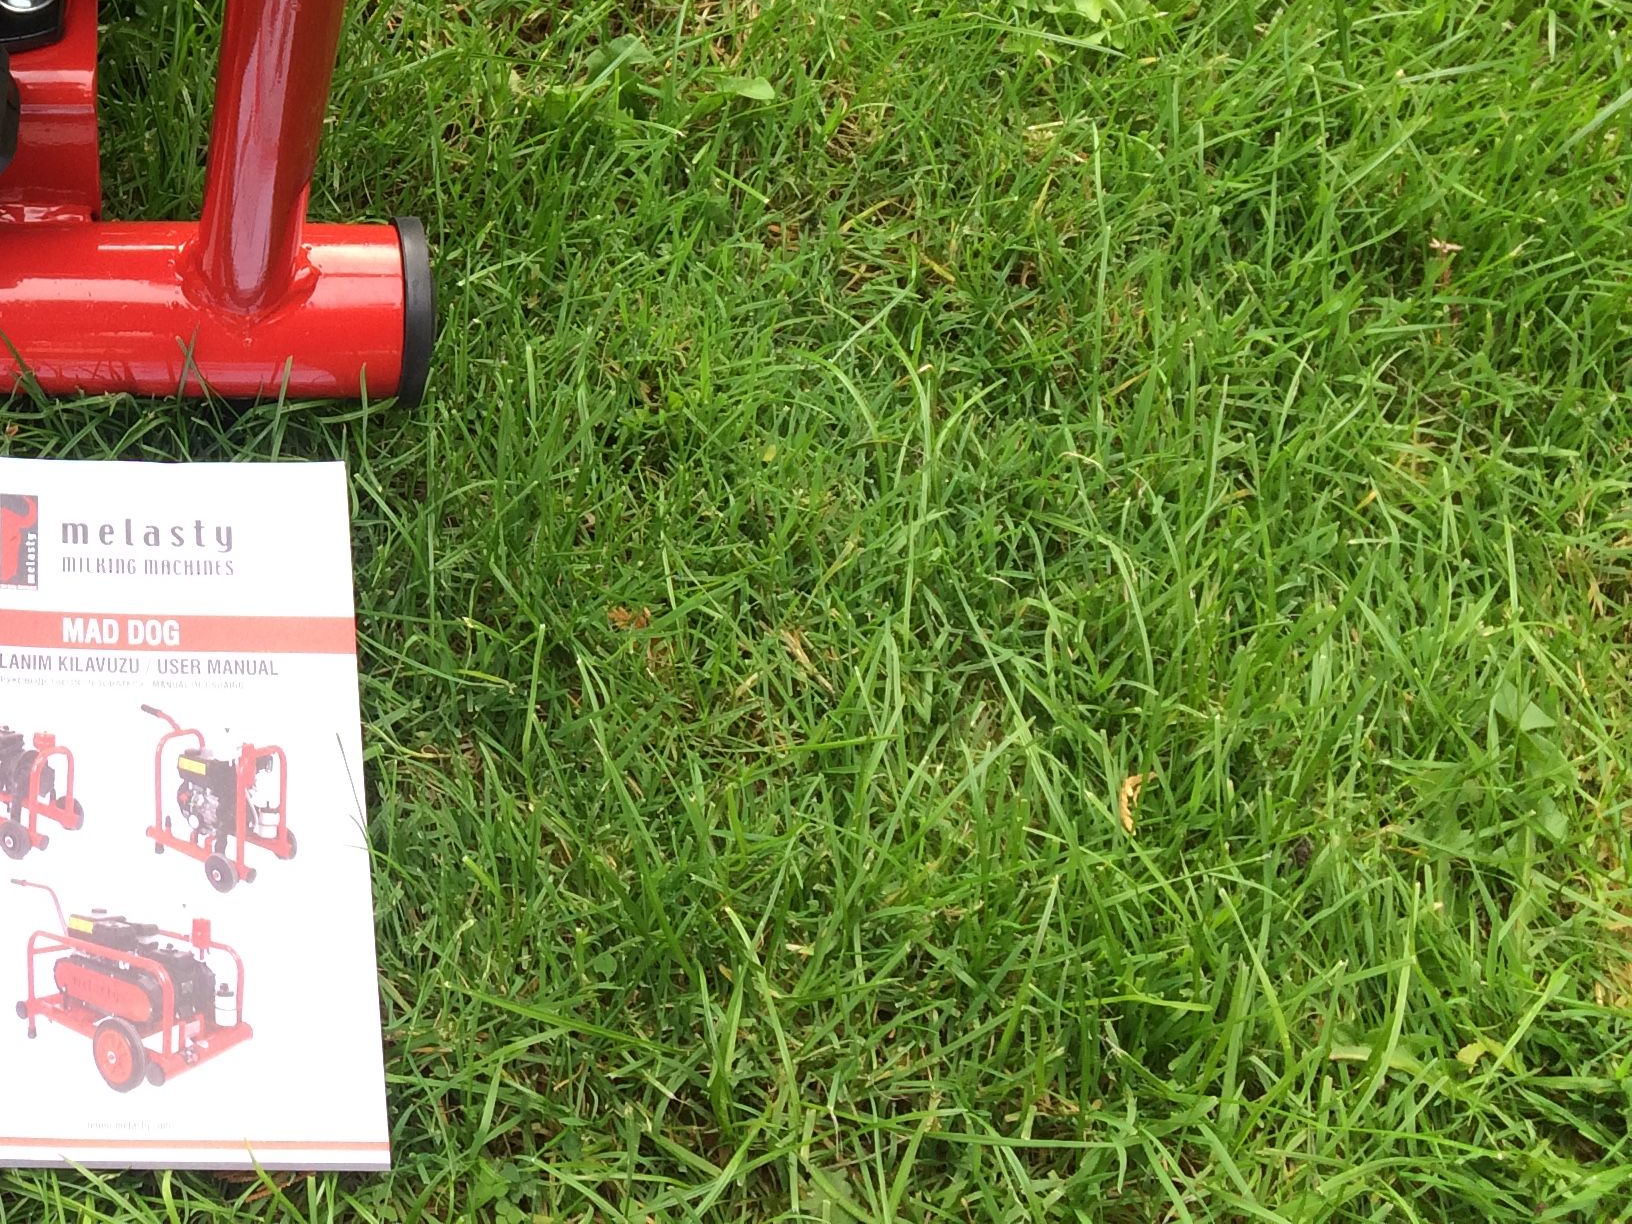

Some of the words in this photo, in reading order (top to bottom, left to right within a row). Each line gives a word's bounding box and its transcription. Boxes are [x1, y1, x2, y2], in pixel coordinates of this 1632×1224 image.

[61, 518, 234, 553] melasty
[25, 532, 38, 584] melasty
[61, 556, 137, 576] MILKING
[143, 559, 235, 577] MACHINES
[62, 616, 120, 645] MAD
[127, 619, 181, 646] DOG
[58, 653, 140, 674] KILAVUZU
[157, 657, 202, 676] USER
[207, 658, 279, 677] MANUAL
